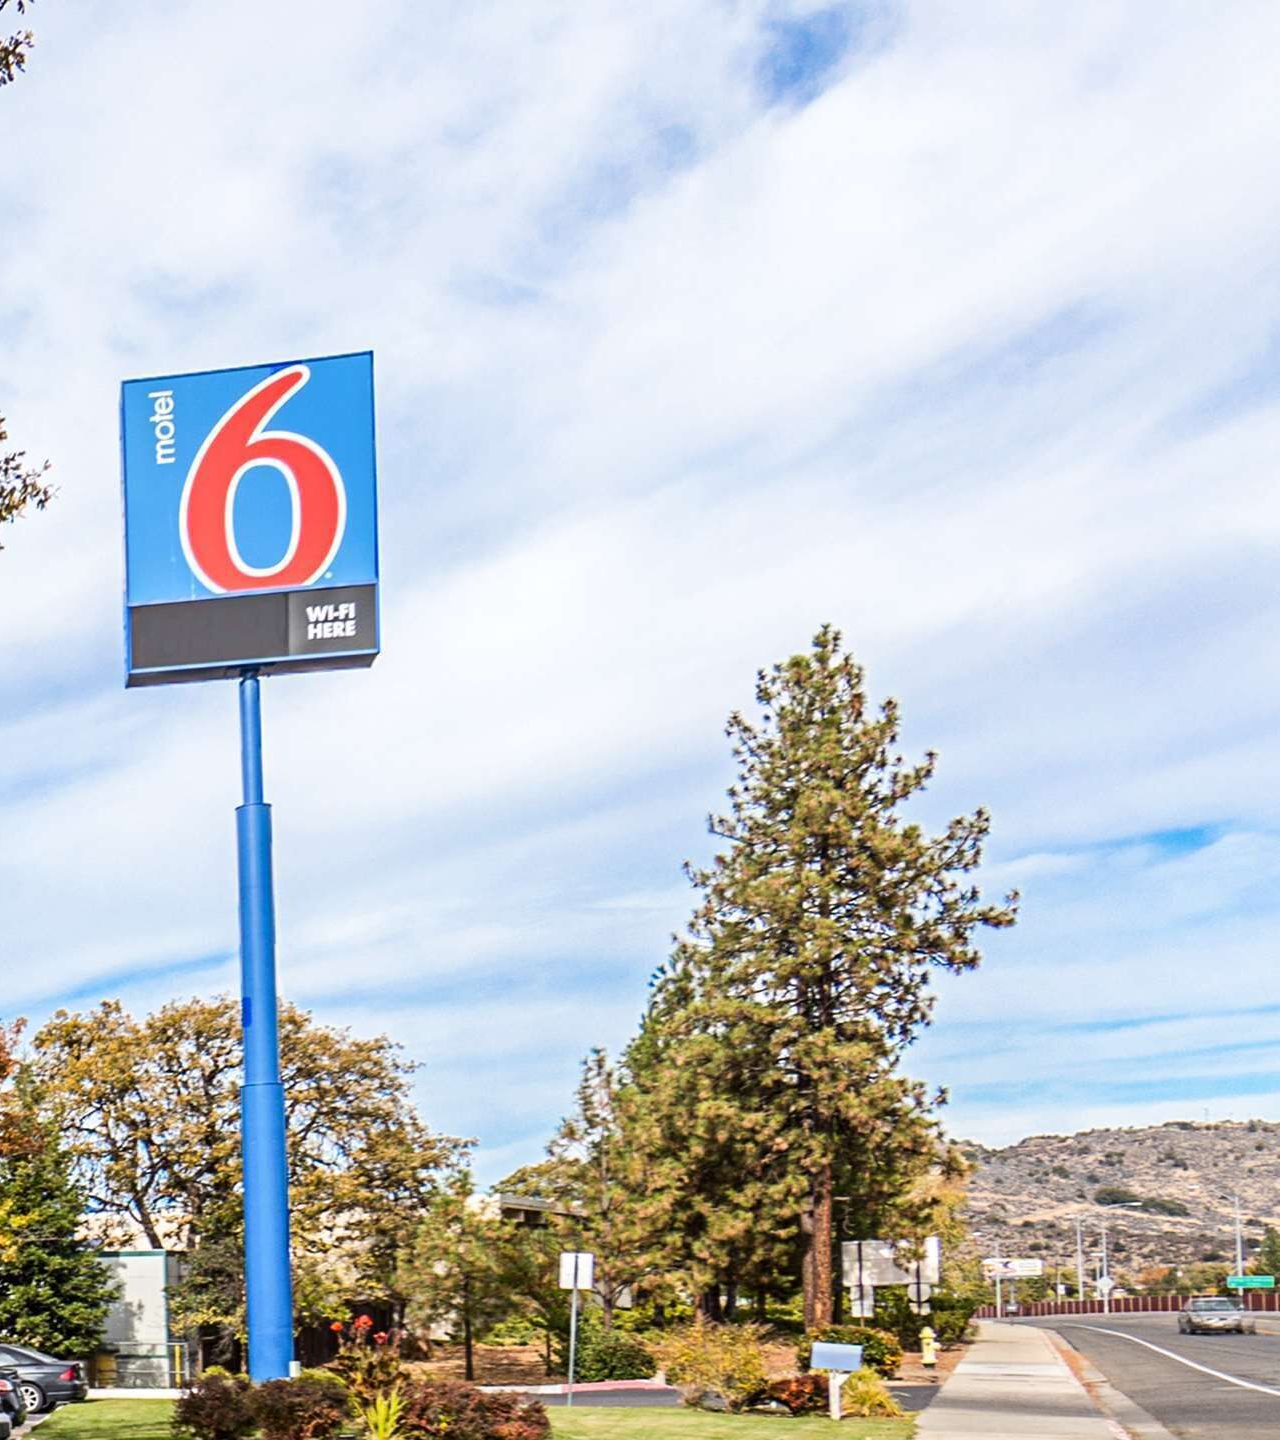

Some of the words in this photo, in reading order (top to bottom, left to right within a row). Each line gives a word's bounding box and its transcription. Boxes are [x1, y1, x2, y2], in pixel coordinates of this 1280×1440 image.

[148, 390, 175, 464] motel
[179, 364, 346, 594] 6
[306, 602, 356, 622] WI-FI
[307, 620, 356, 640] HERE
